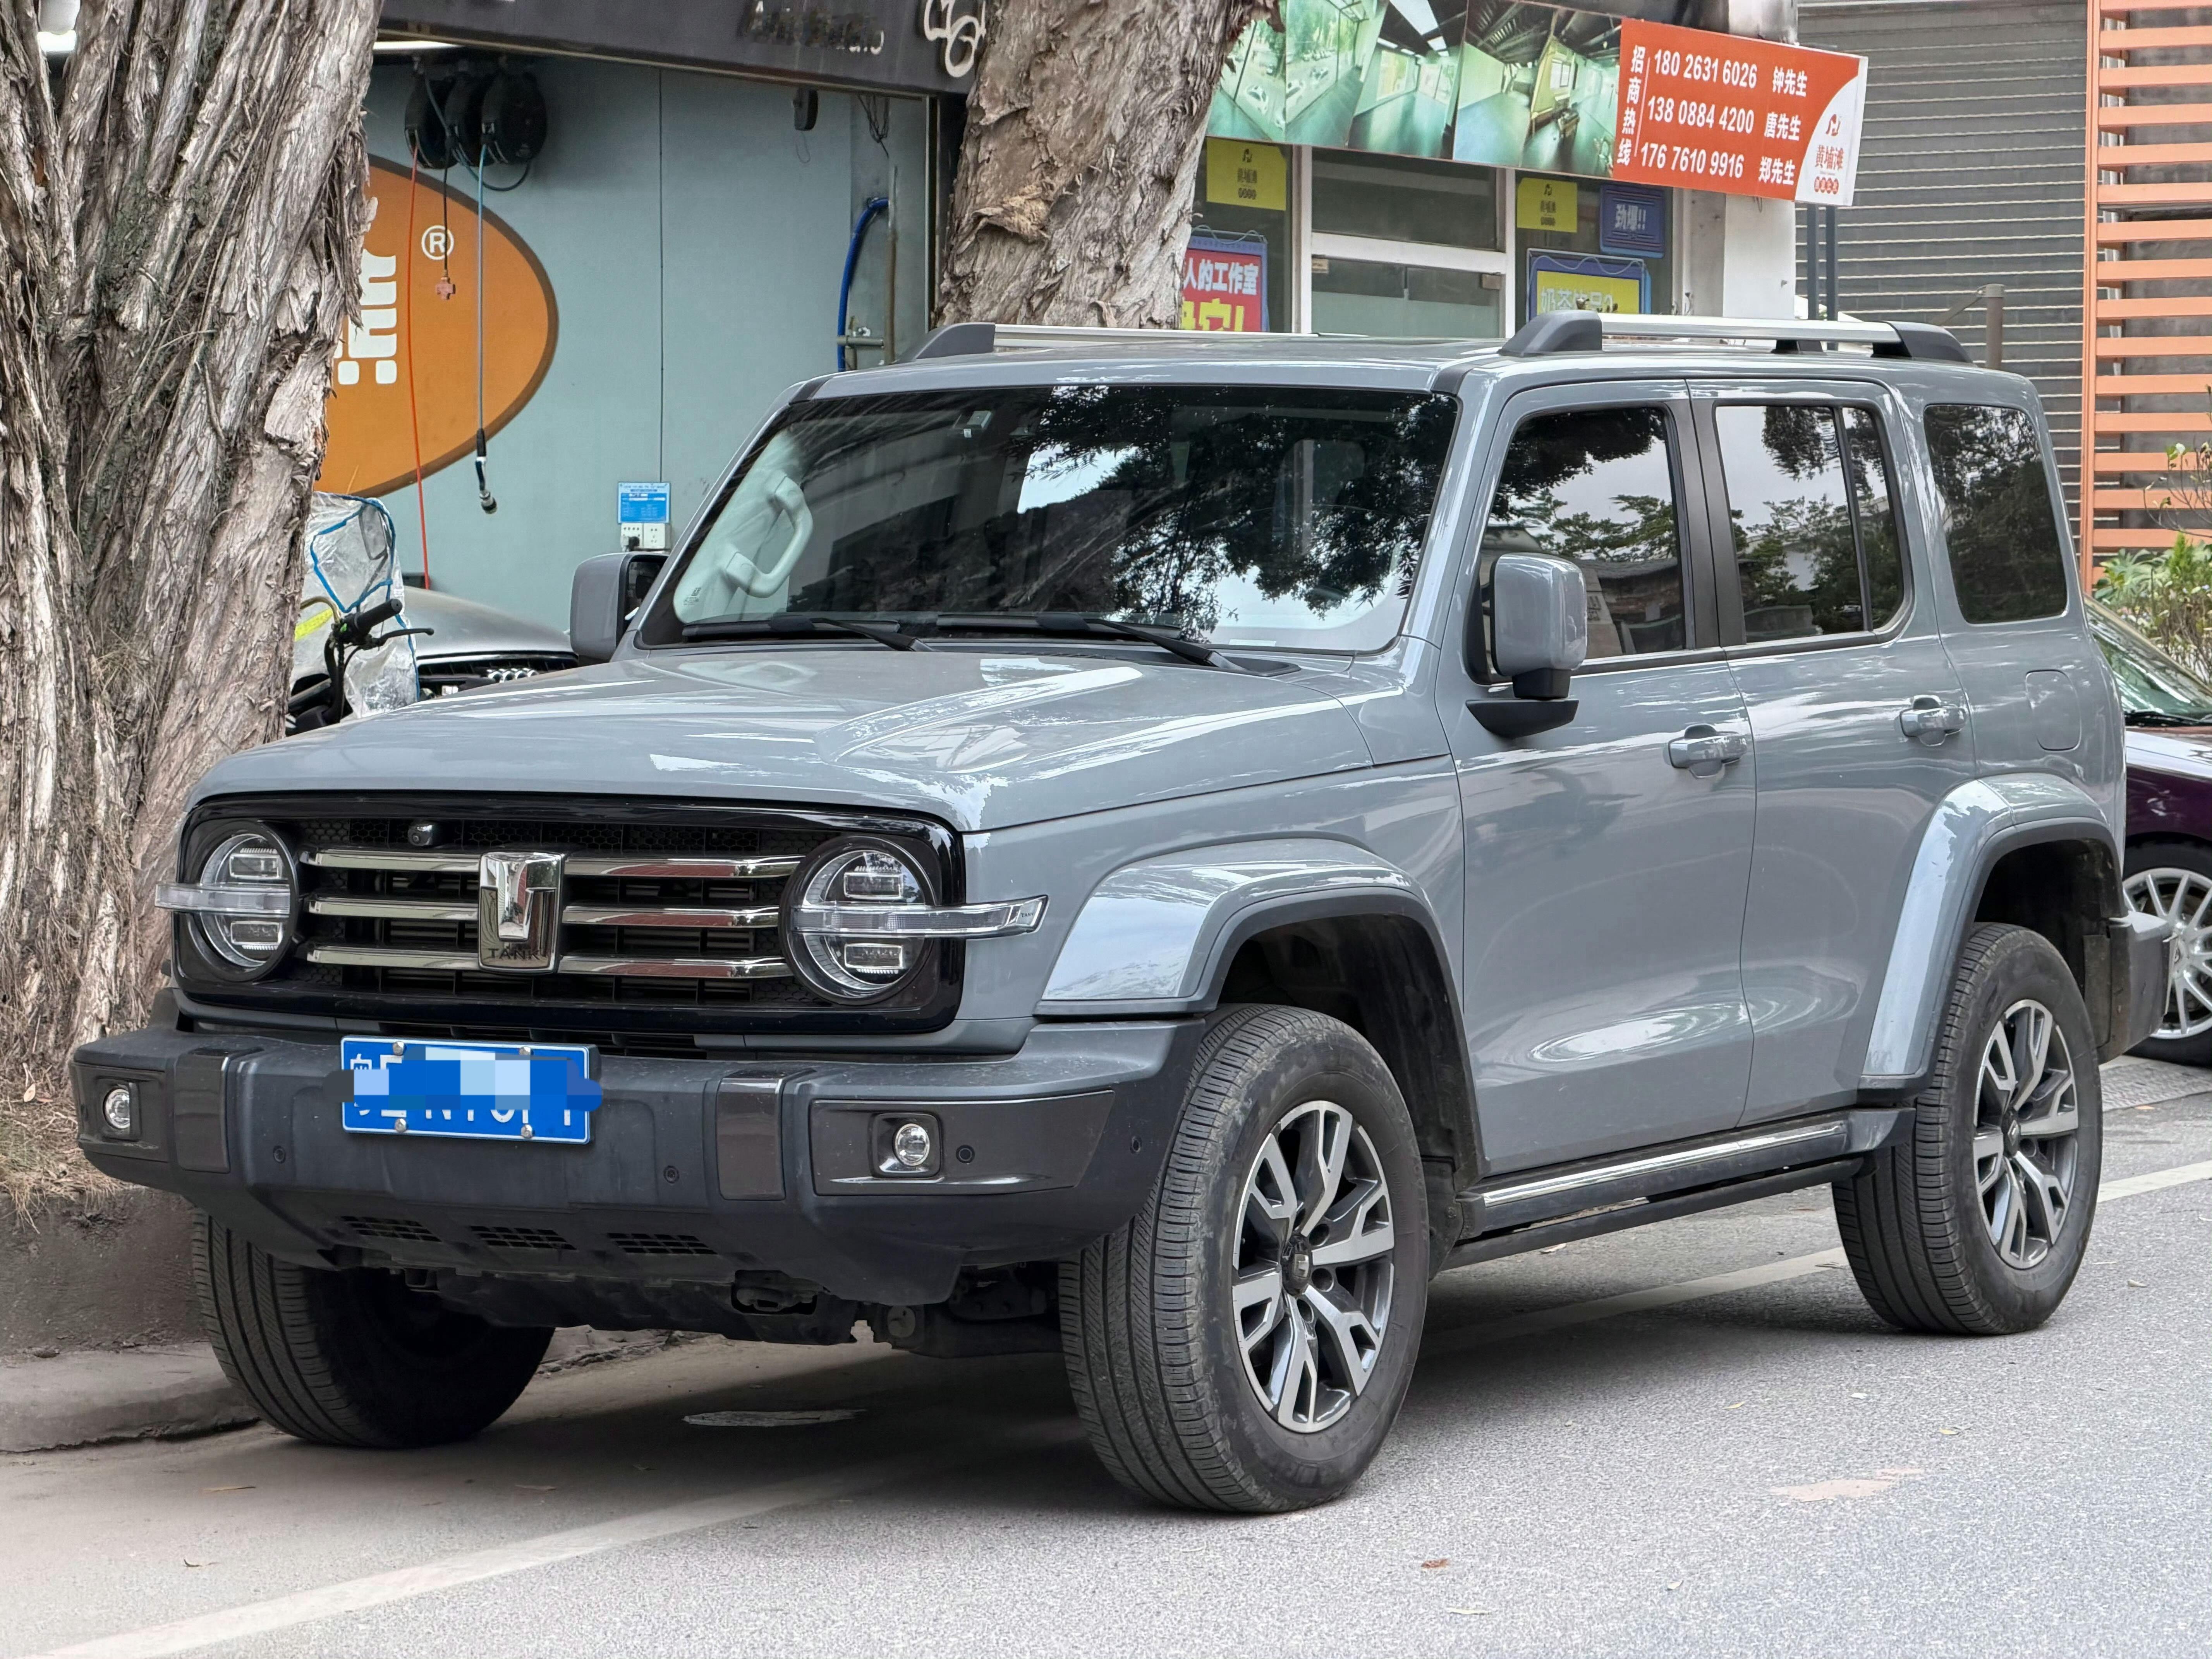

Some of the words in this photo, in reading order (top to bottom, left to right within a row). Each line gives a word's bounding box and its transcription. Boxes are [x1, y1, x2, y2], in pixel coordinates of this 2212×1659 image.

[1654, 49, 1680, 76] 180
[1683, 54, 1719, 83] 2631
[1723, 60, 1757, 89] 6026
[1772, 66, 1808, 97] 钟先生
[1617, 45, 1645, 166] 招商热线
[1648, 96, 1674, 123] 138
[1678, 100, 1715, 128] 0884
[1719, 106, 1754, 134] 4200
[1764, 112, 1801, 141] 唐先生
[1641, 142, 1667, 169] 176
[1671, 146, 1706, 173] 7610
[1709, 151, 1744, 178] 9916
[1758, 156, 1795, 185] 郑先生
[488, 948, 540, 960] TANK
